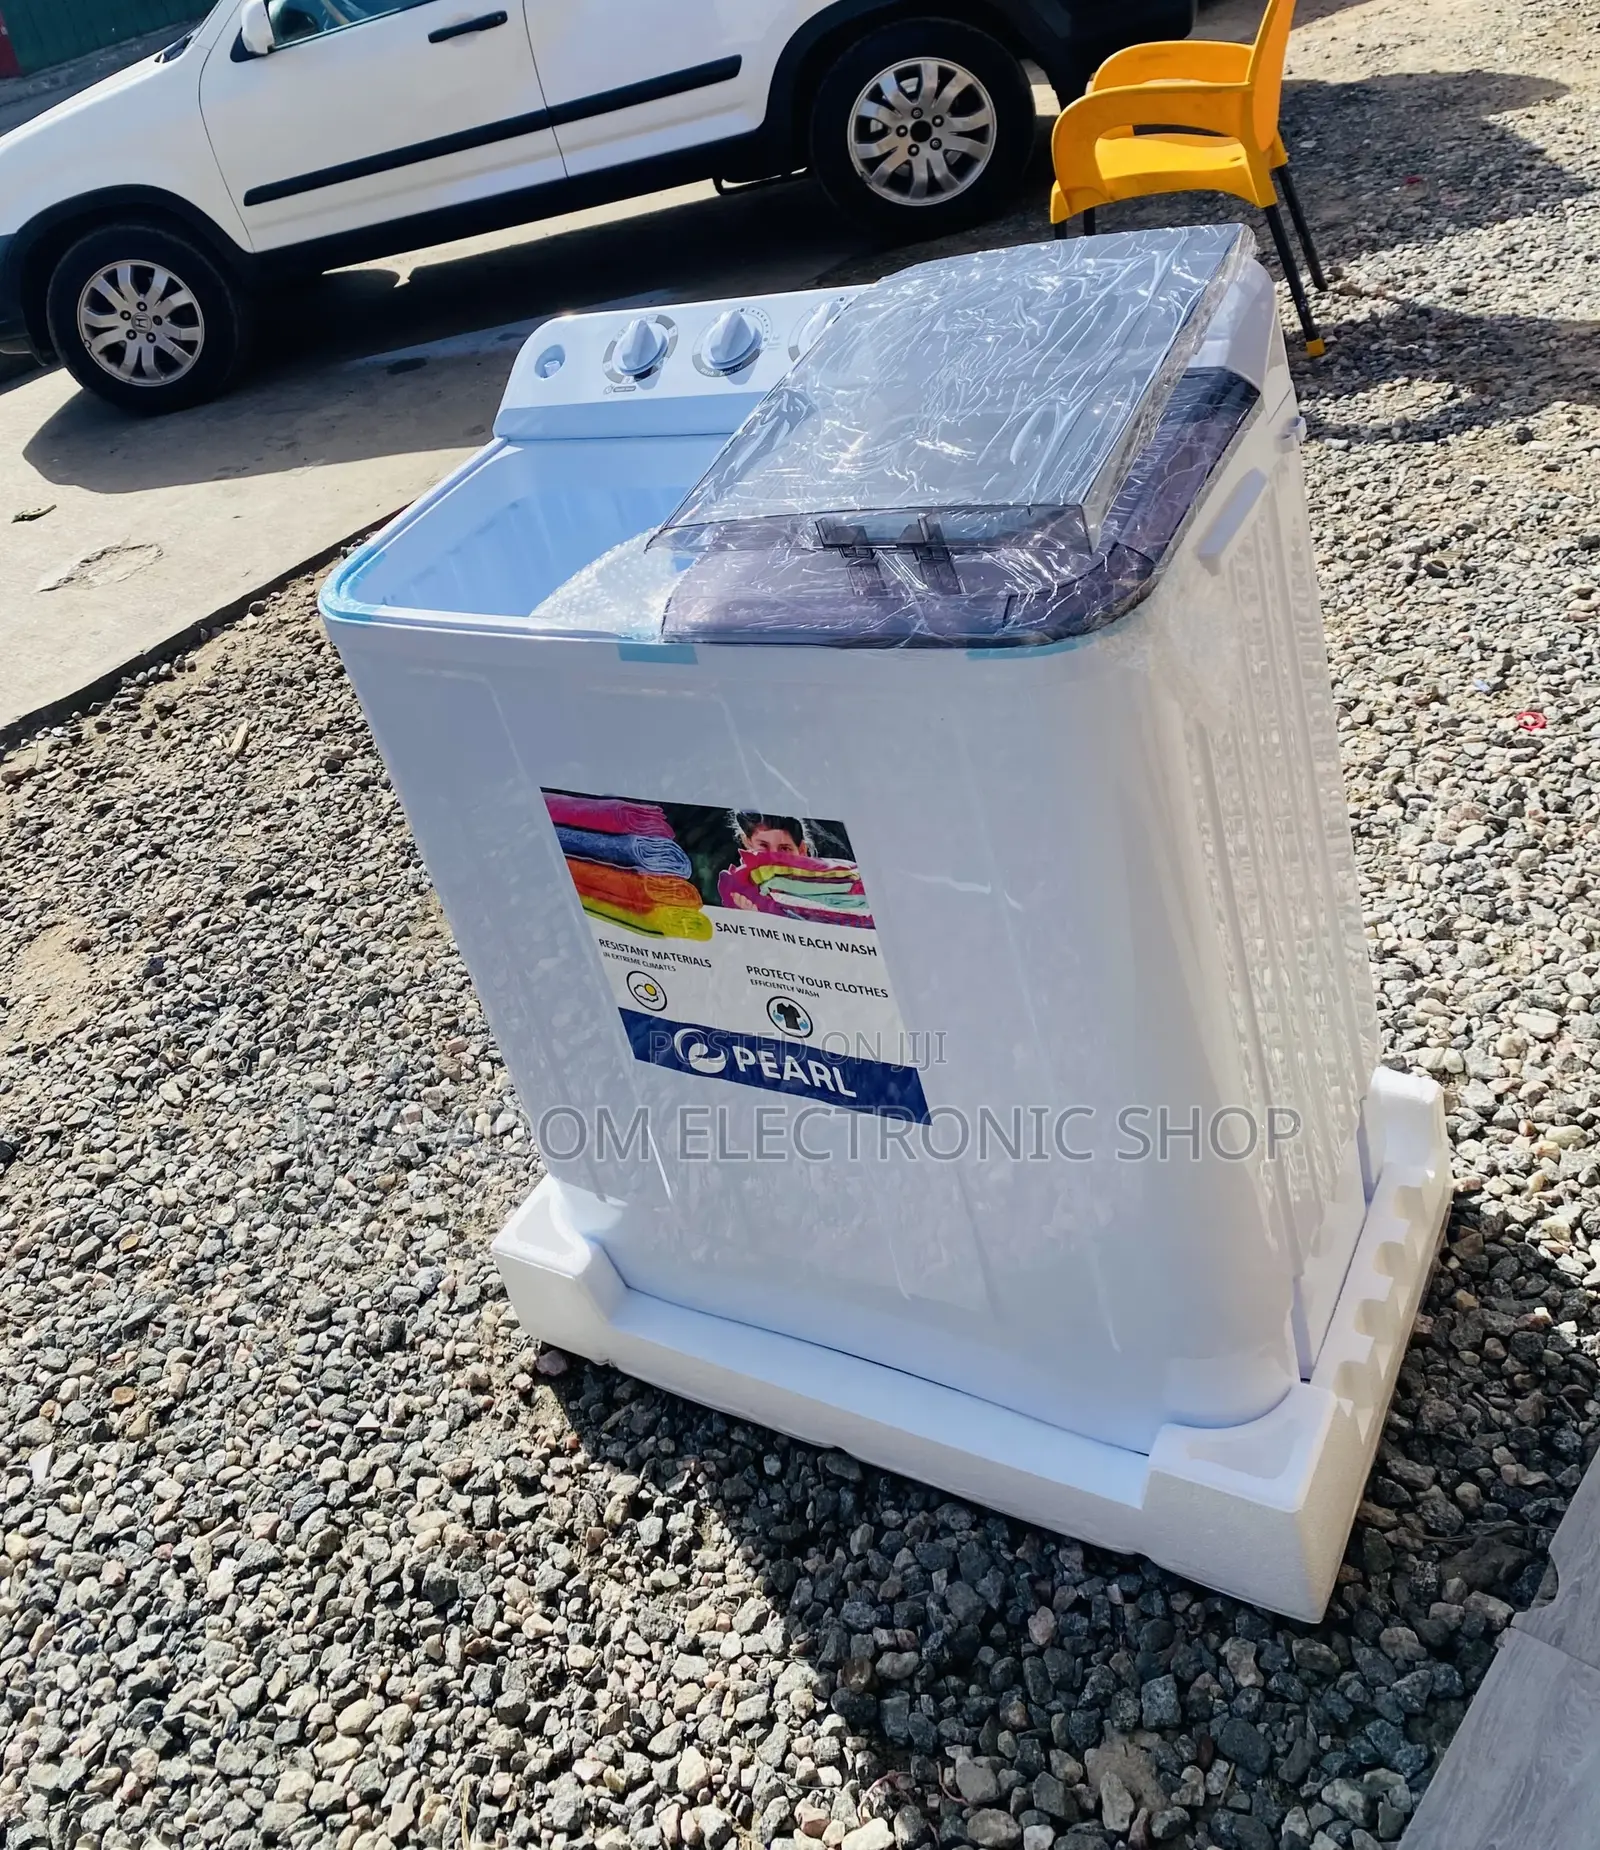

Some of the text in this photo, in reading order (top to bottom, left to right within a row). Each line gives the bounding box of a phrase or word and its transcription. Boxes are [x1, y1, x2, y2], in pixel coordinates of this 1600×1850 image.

[598, 938, 712, 968] RESISTANT MATERIALS
[715, 922, 878, 957] SAVE TIME IN EACH WASH
[603, 951, 677, 972] IN EXTREME CLIMATES
[746, 965, 889, 998] PROTECT YOUR CLOTHES
[750, 979, 820, 998] EFFICIENTLY WASH
[732, 1045, 857, 1098] PEARL
